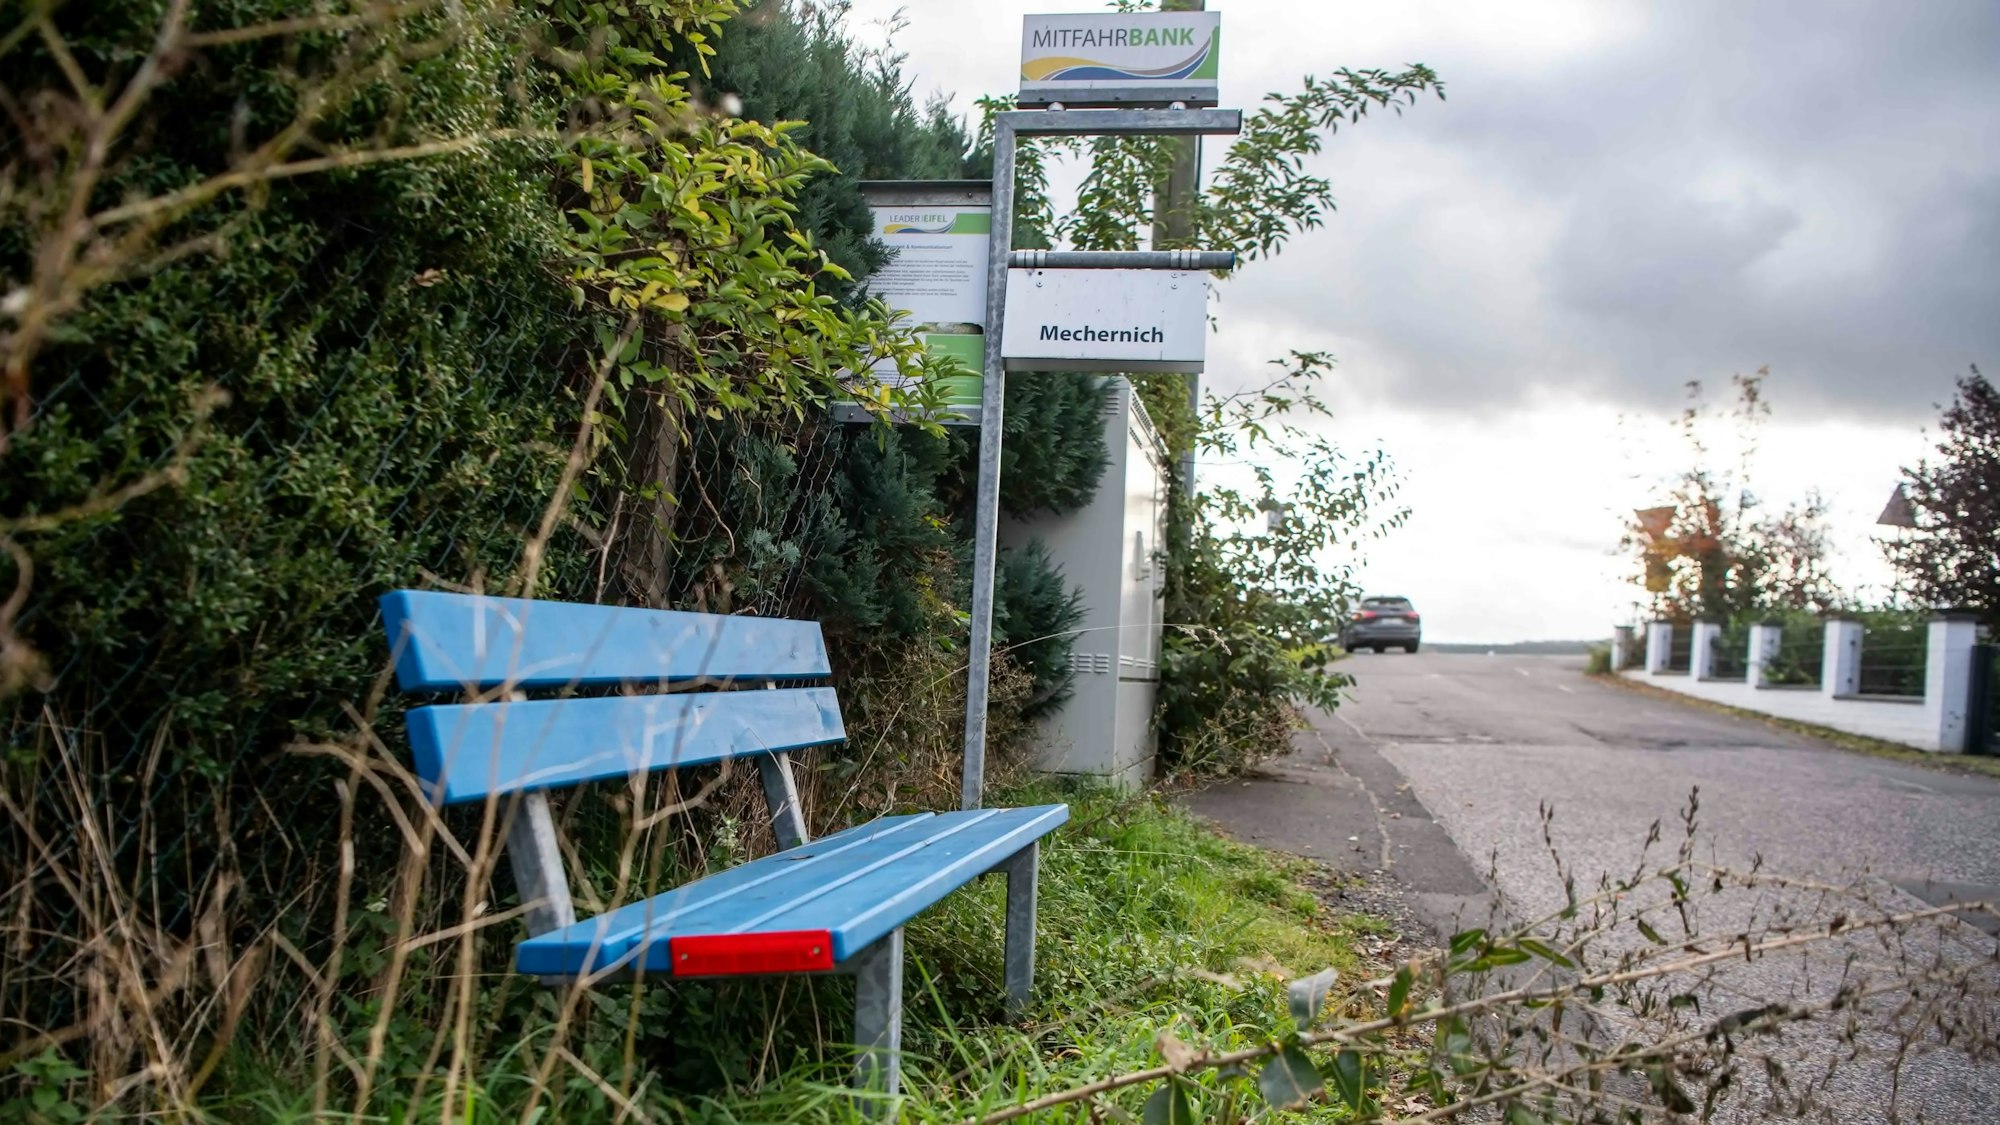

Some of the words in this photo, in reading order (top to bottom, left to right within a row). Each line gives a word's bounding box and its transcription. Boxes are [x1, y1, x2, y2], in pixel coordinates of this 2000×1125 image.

[1032, 27, 1195, 48] MITFAHRBANK
[889, 214, 920, 223] LEADER
[923, 214, 948, 223] EIFEL
[1039, 325, 1164, 343] Mechernich
